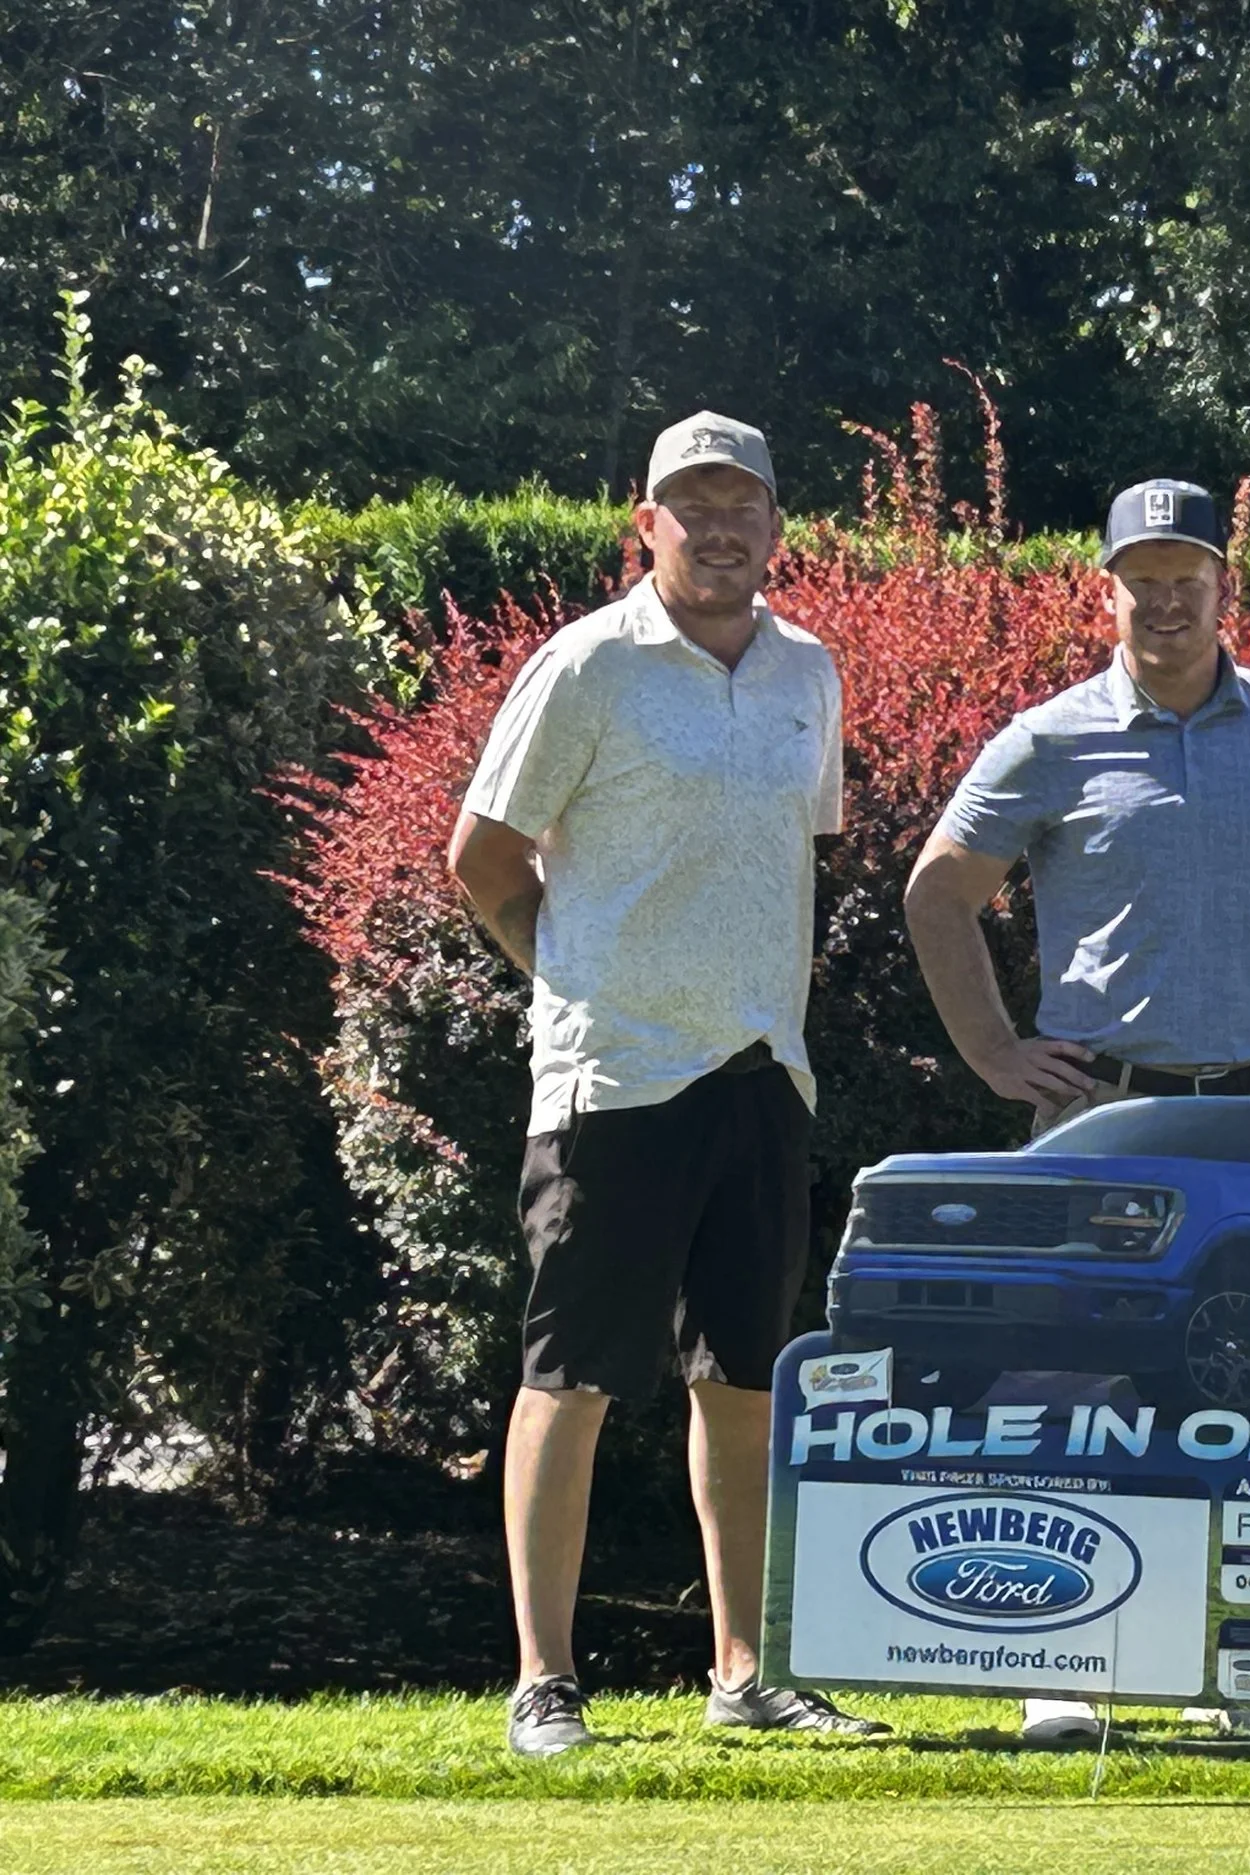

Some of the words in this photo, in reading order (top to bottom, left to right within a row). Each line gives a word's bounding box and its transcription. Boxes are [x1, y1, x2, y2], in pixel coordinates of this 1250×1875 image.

[789, 1405, 1049, 1466] HOLE
[1064, 1405, 1157, 1459] IN
[907, 1507, 1101, 1565] NEWBERG
[945, 1558, 1057, 1607] Ford
[886, 1642, 1107, 1674] newbergford.com
